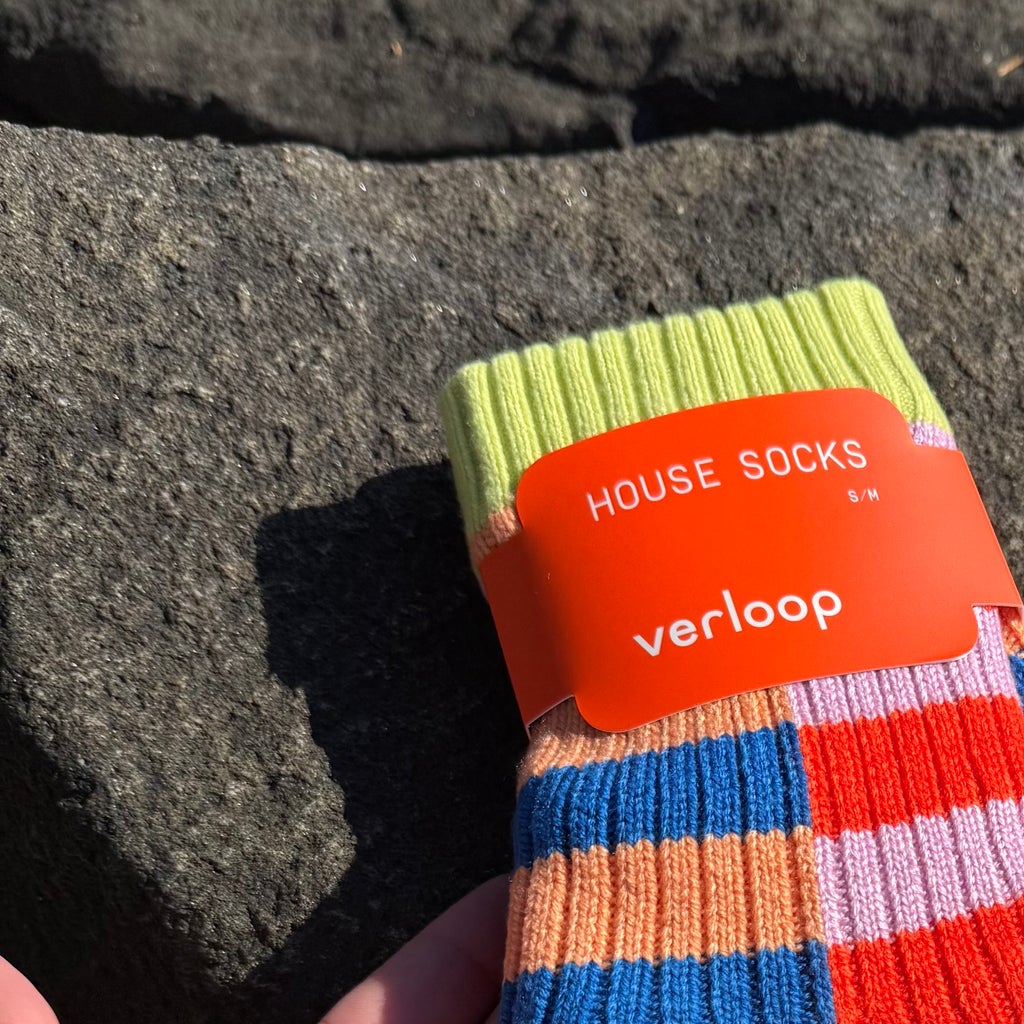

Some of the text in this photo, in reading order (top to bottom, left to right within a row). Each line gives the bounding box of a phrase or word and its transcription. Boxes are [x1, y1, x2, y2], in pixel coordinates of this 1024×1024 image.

[586, 439, 868, 522] HOUSE SOCKS
[847, 488, 880, 504] S/M
[632, 589, 843, 658] verloop
